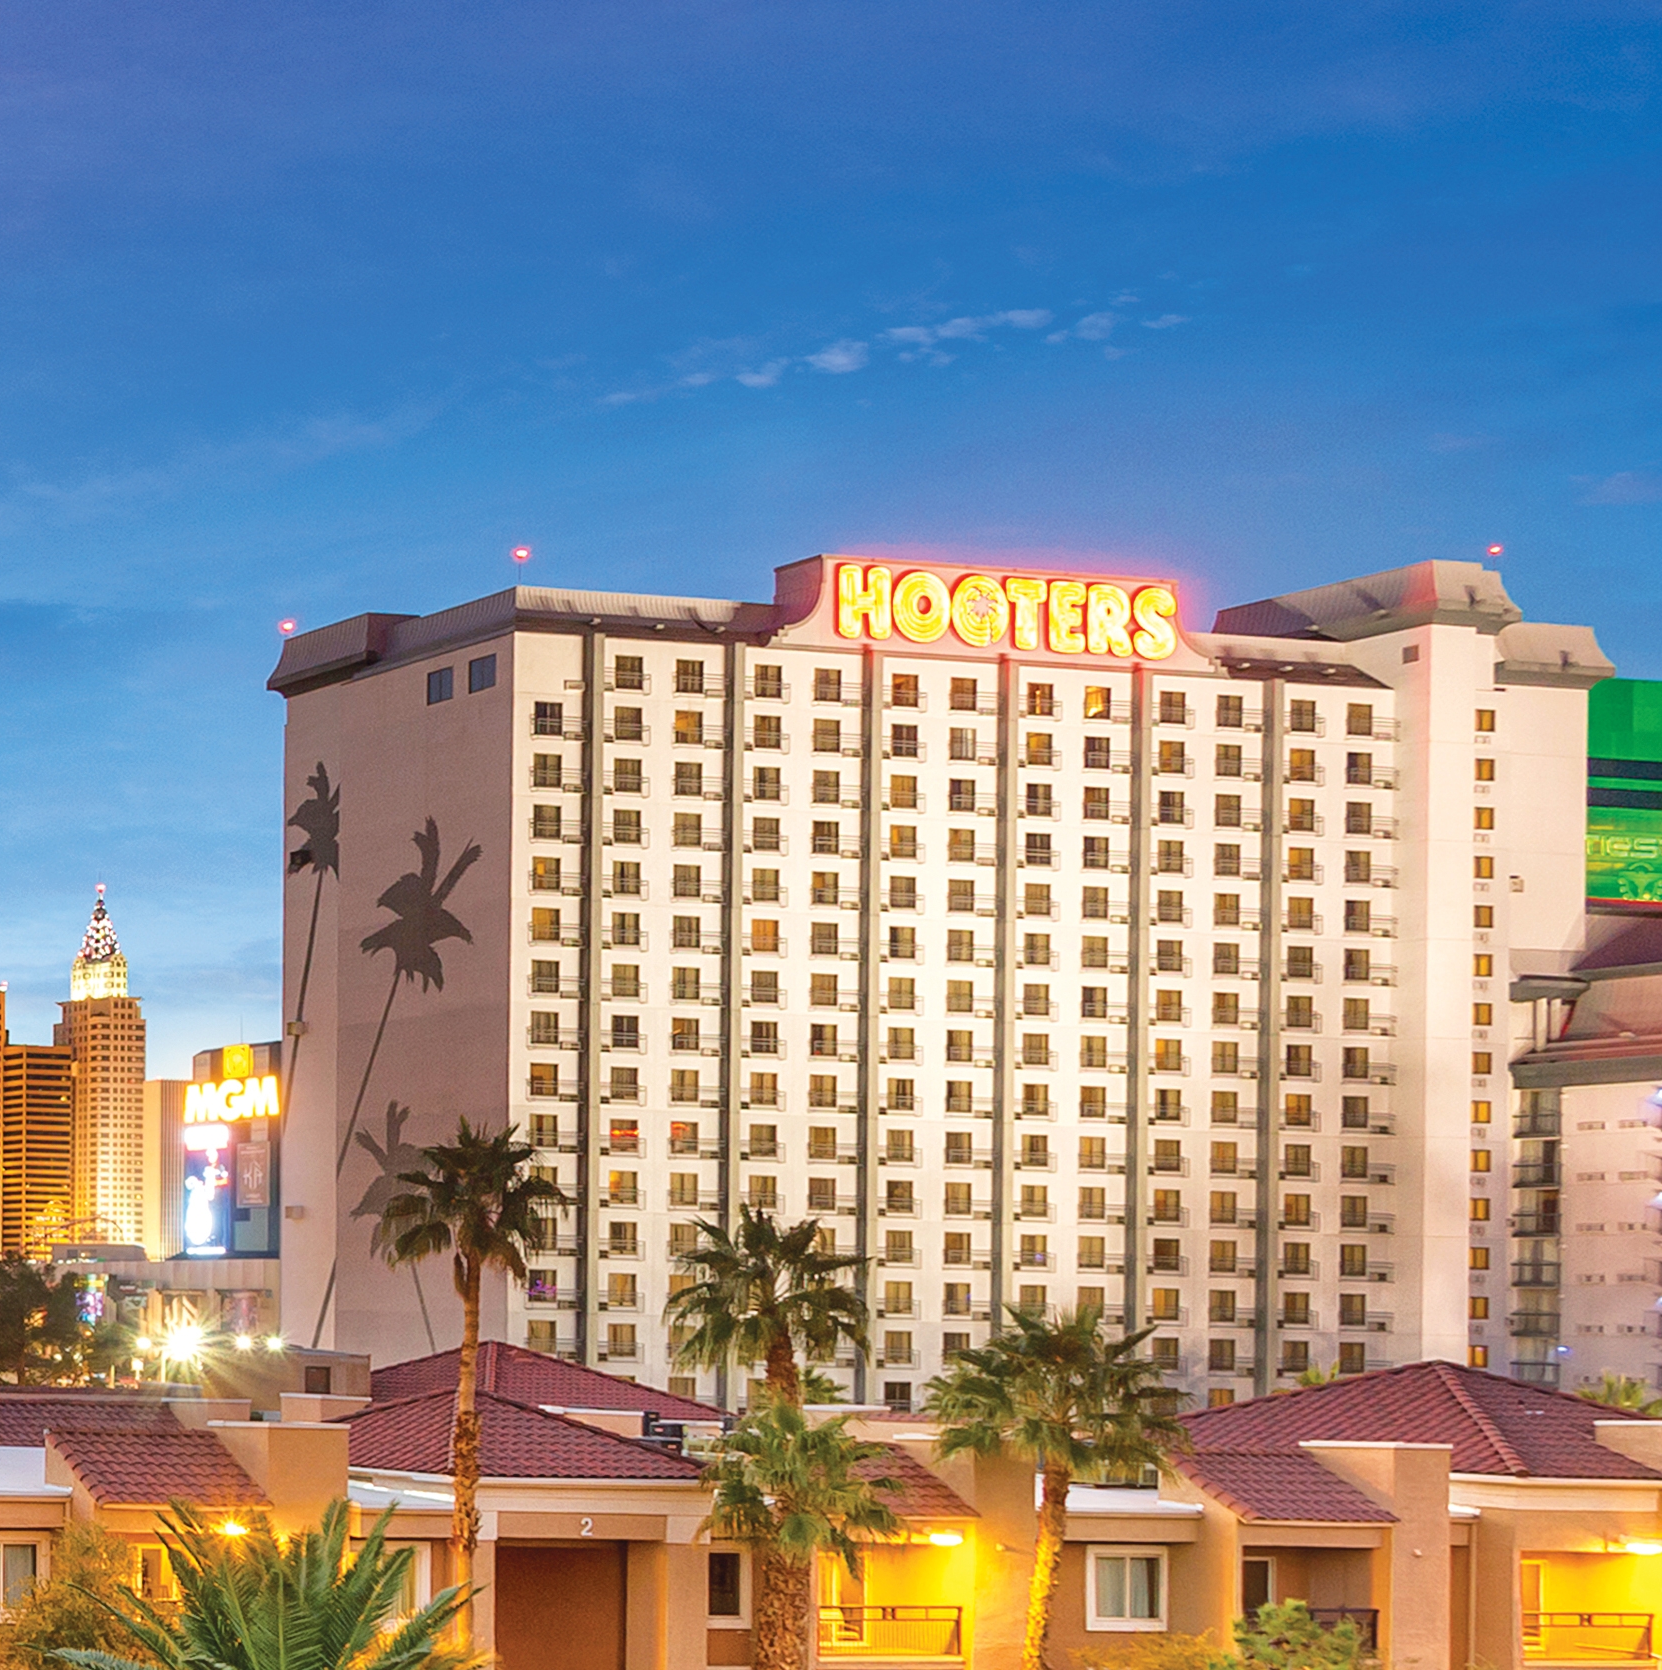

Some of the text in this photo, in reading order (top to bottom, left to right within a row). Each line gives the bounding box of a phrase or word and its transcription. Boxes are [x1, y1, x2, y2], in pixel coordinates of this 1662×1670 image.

[837, 563, 1178, 660] HOOTERS
[184, 1076, 280, 1124] MGM
[580, 1517, 593, 1537] 2
